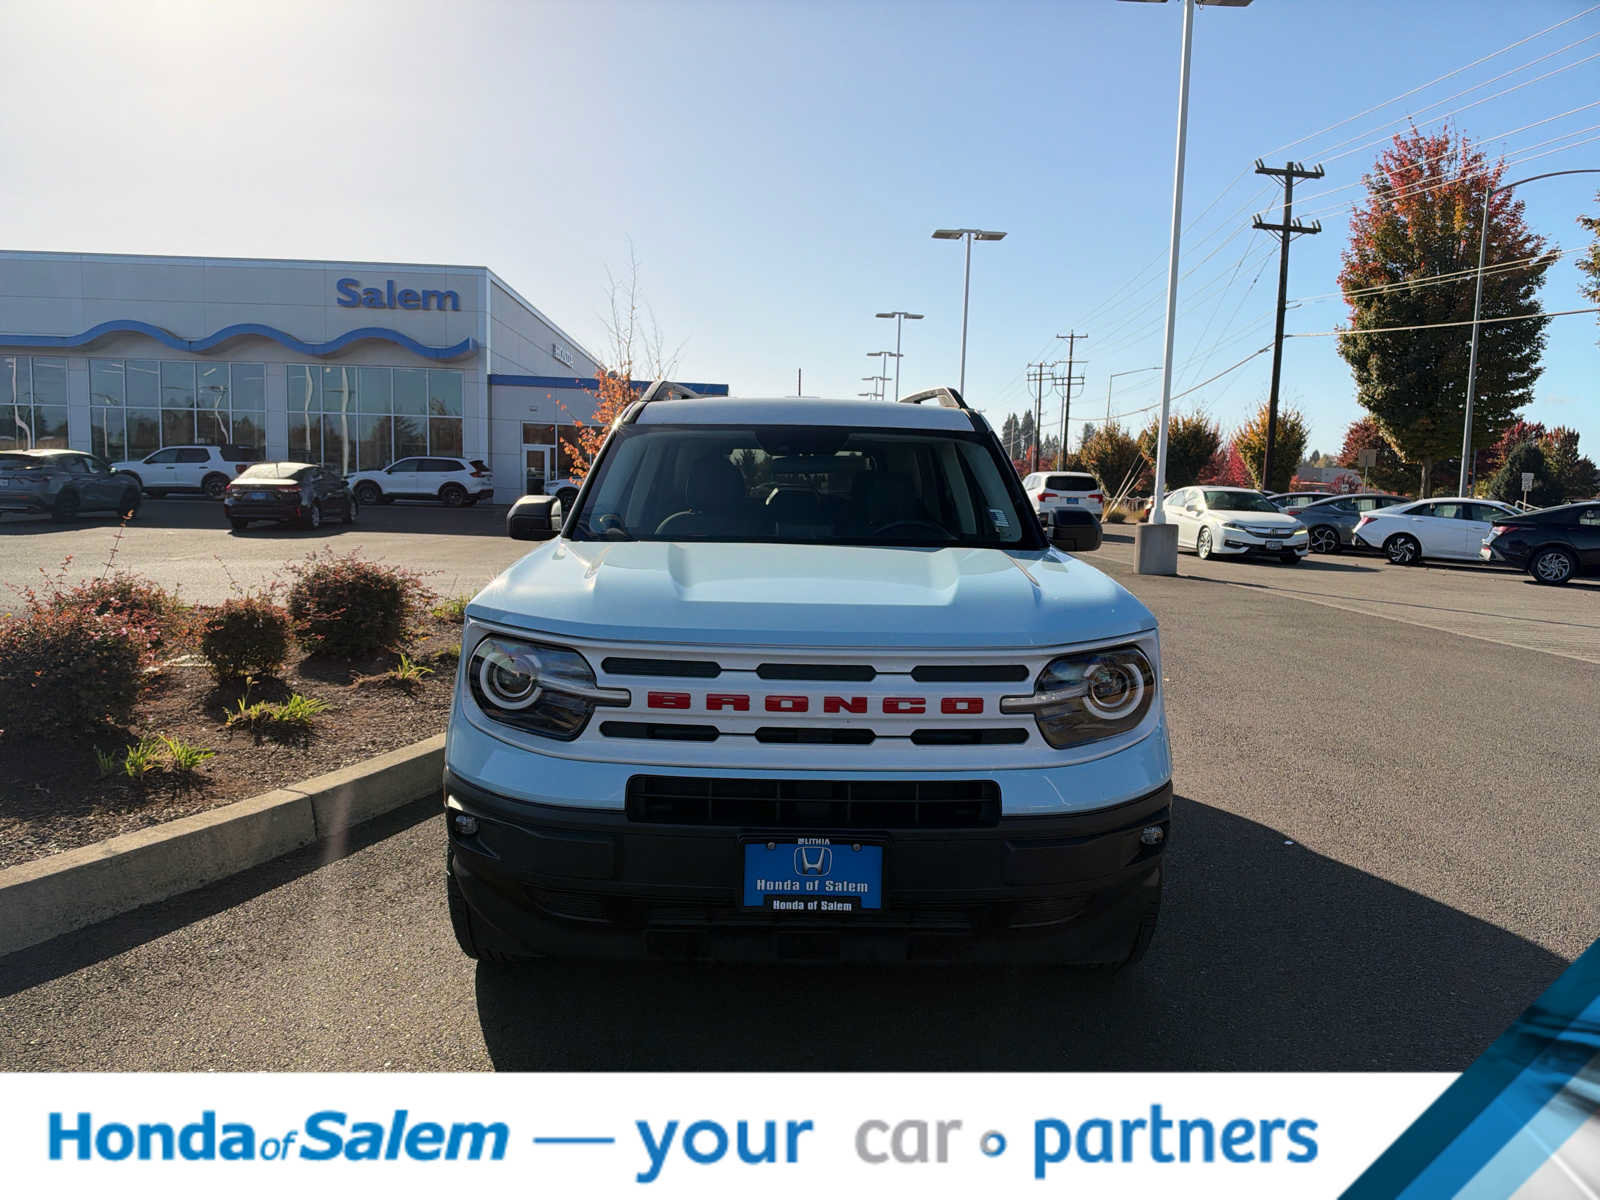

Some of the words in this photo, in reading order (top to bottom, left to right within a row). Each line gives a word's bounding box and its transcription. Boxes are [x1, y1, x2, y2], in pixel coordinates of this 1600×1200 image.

[336, 277, 460, 311] Salem
[647, 691, 985, 715] BRONCO
[756, 879, 800, 891] Honda
[806, 880, 819, 891] of
[825, 880, 868, 893] Salem
[773, 900, 804, 910] Honda
[808, 901, 818, 910] of
[821, 901, 852, 911] Salem
